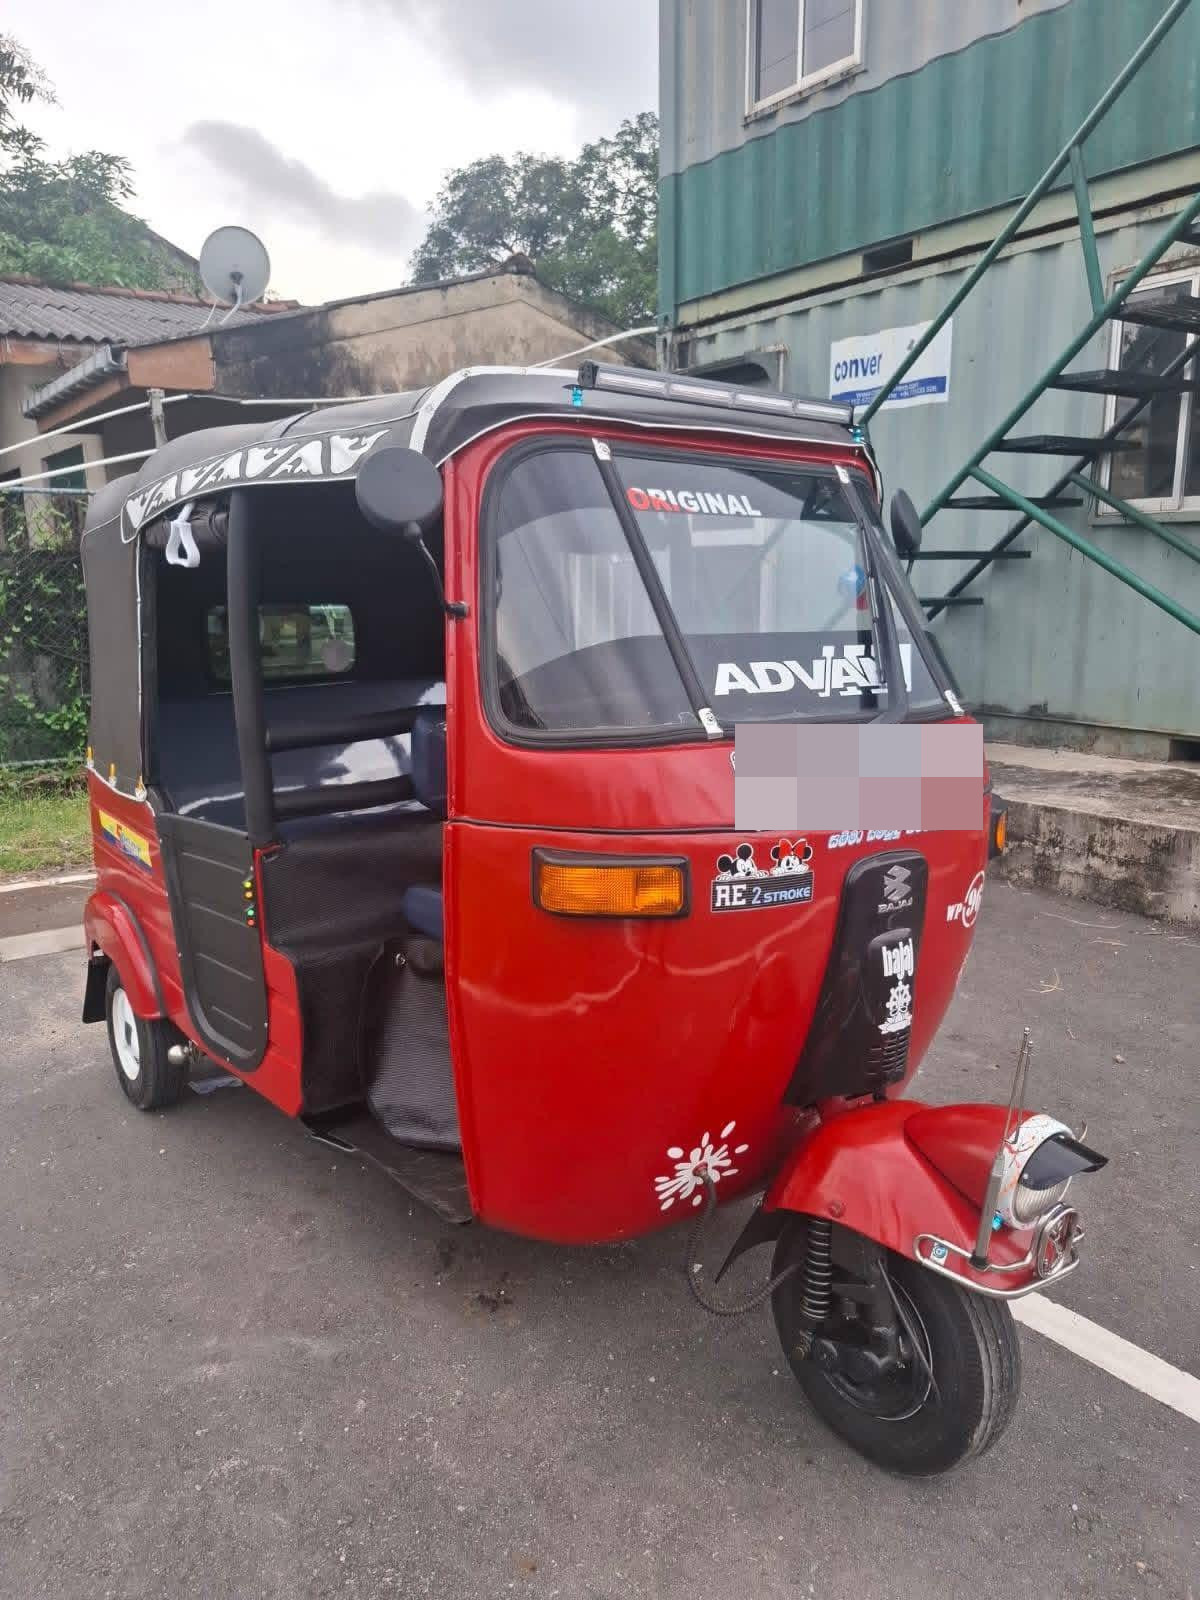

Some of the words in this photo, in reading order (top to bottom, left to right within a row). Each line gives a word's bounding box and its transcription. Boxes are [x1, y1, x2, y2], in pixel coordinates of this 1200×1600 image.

[626, 487, 761, 516] ORIGINAL
[715, 884, 747, 907] RE
[751, 886, 762, 905] 2
[763, 886, 811, 903] STROKE
[877, 897, 913, 914] BAJAJ
